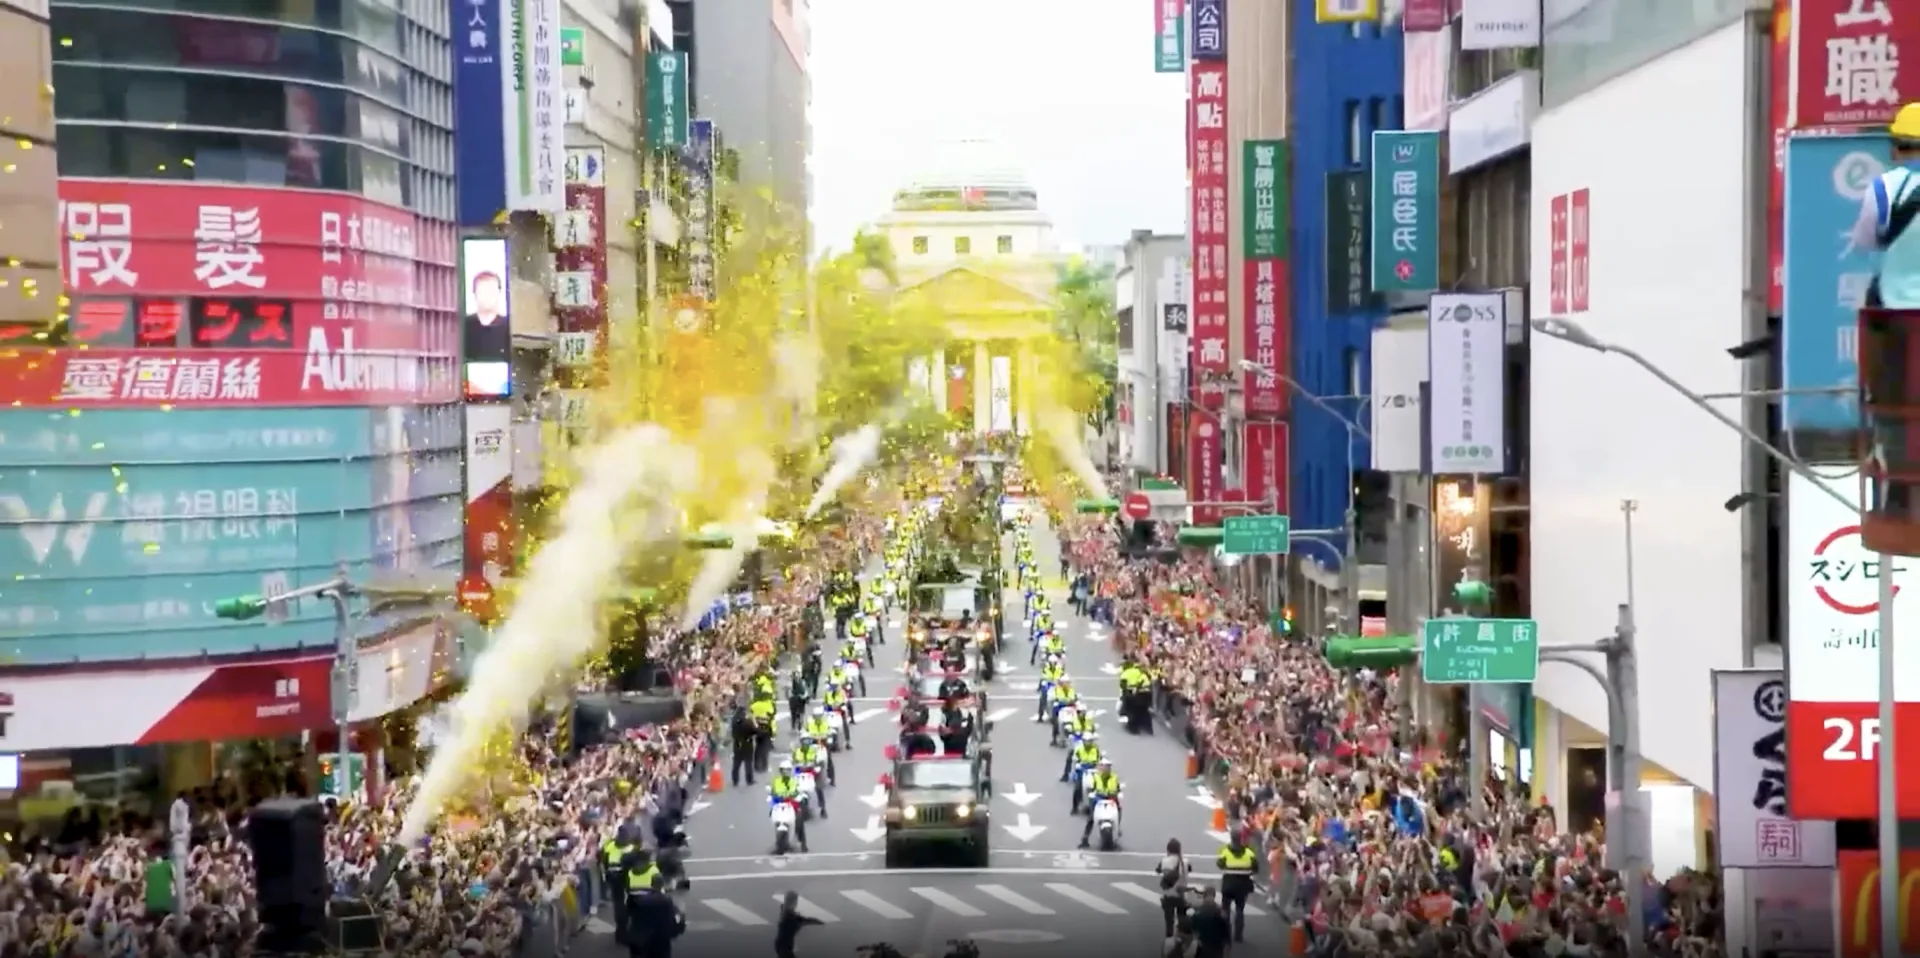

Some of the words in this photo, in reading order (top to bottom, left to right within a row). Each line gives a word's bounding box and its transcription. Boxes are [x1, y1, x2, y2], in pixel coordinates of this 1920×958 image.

[1198, 4, 1220, 50] 公司
[60, 201, 267, 289] 假髮
[60, 356, 261, 400] 愛德蘭絲
[1443, 622, 1532, 644] 許昌街
